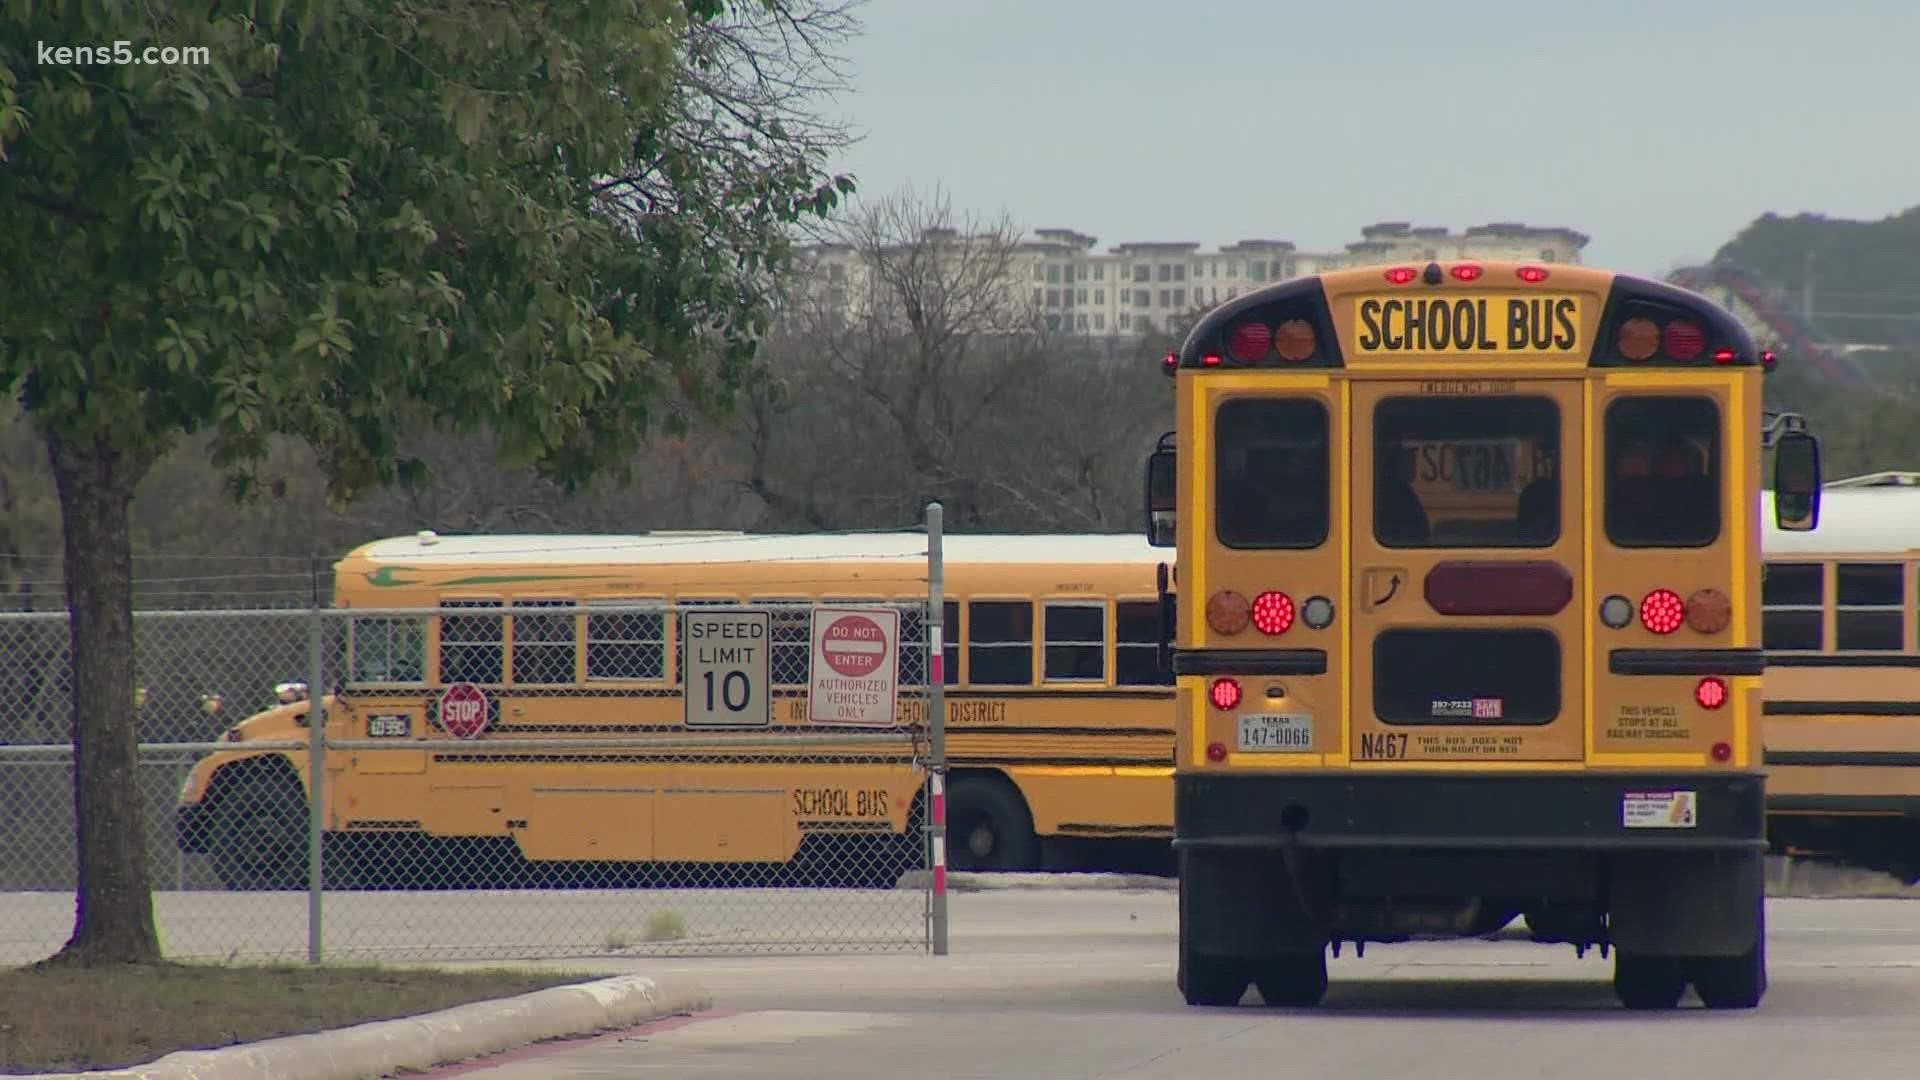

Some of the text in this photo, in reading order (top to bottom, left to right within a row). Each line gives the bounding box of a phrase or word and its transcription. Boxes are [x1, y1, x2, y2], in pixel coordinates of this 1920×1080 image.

[1359, 298, 1577, 351] SCHOOL BUS
[691, 623, 763, 639] SPEED
[832, 626, 878, 639] DO NOT
[699, 647, 755, 664] LIMIT
[835, 655, 873, 667] ENTER
[703, 670, 751, 712] 10
[818, 679, 888, 693] AUTHORIZED
[827, 693, 879, 705] VEHICLES
[447, 701, 481, 722] STOP
[838, 706, 866, 719] ONLY
[950, 701, 1006, 723] DISTRICT
[1262, 716, 1290, 724] TEXAS
[1243, 727, 1309, 746] 147-0066
[1418, 735, 1523, 745] THIS BUS DOES NOT
[1361, 732, 1408, 759] N467
[792, 789, 888, 816] SCHOOL BUS
